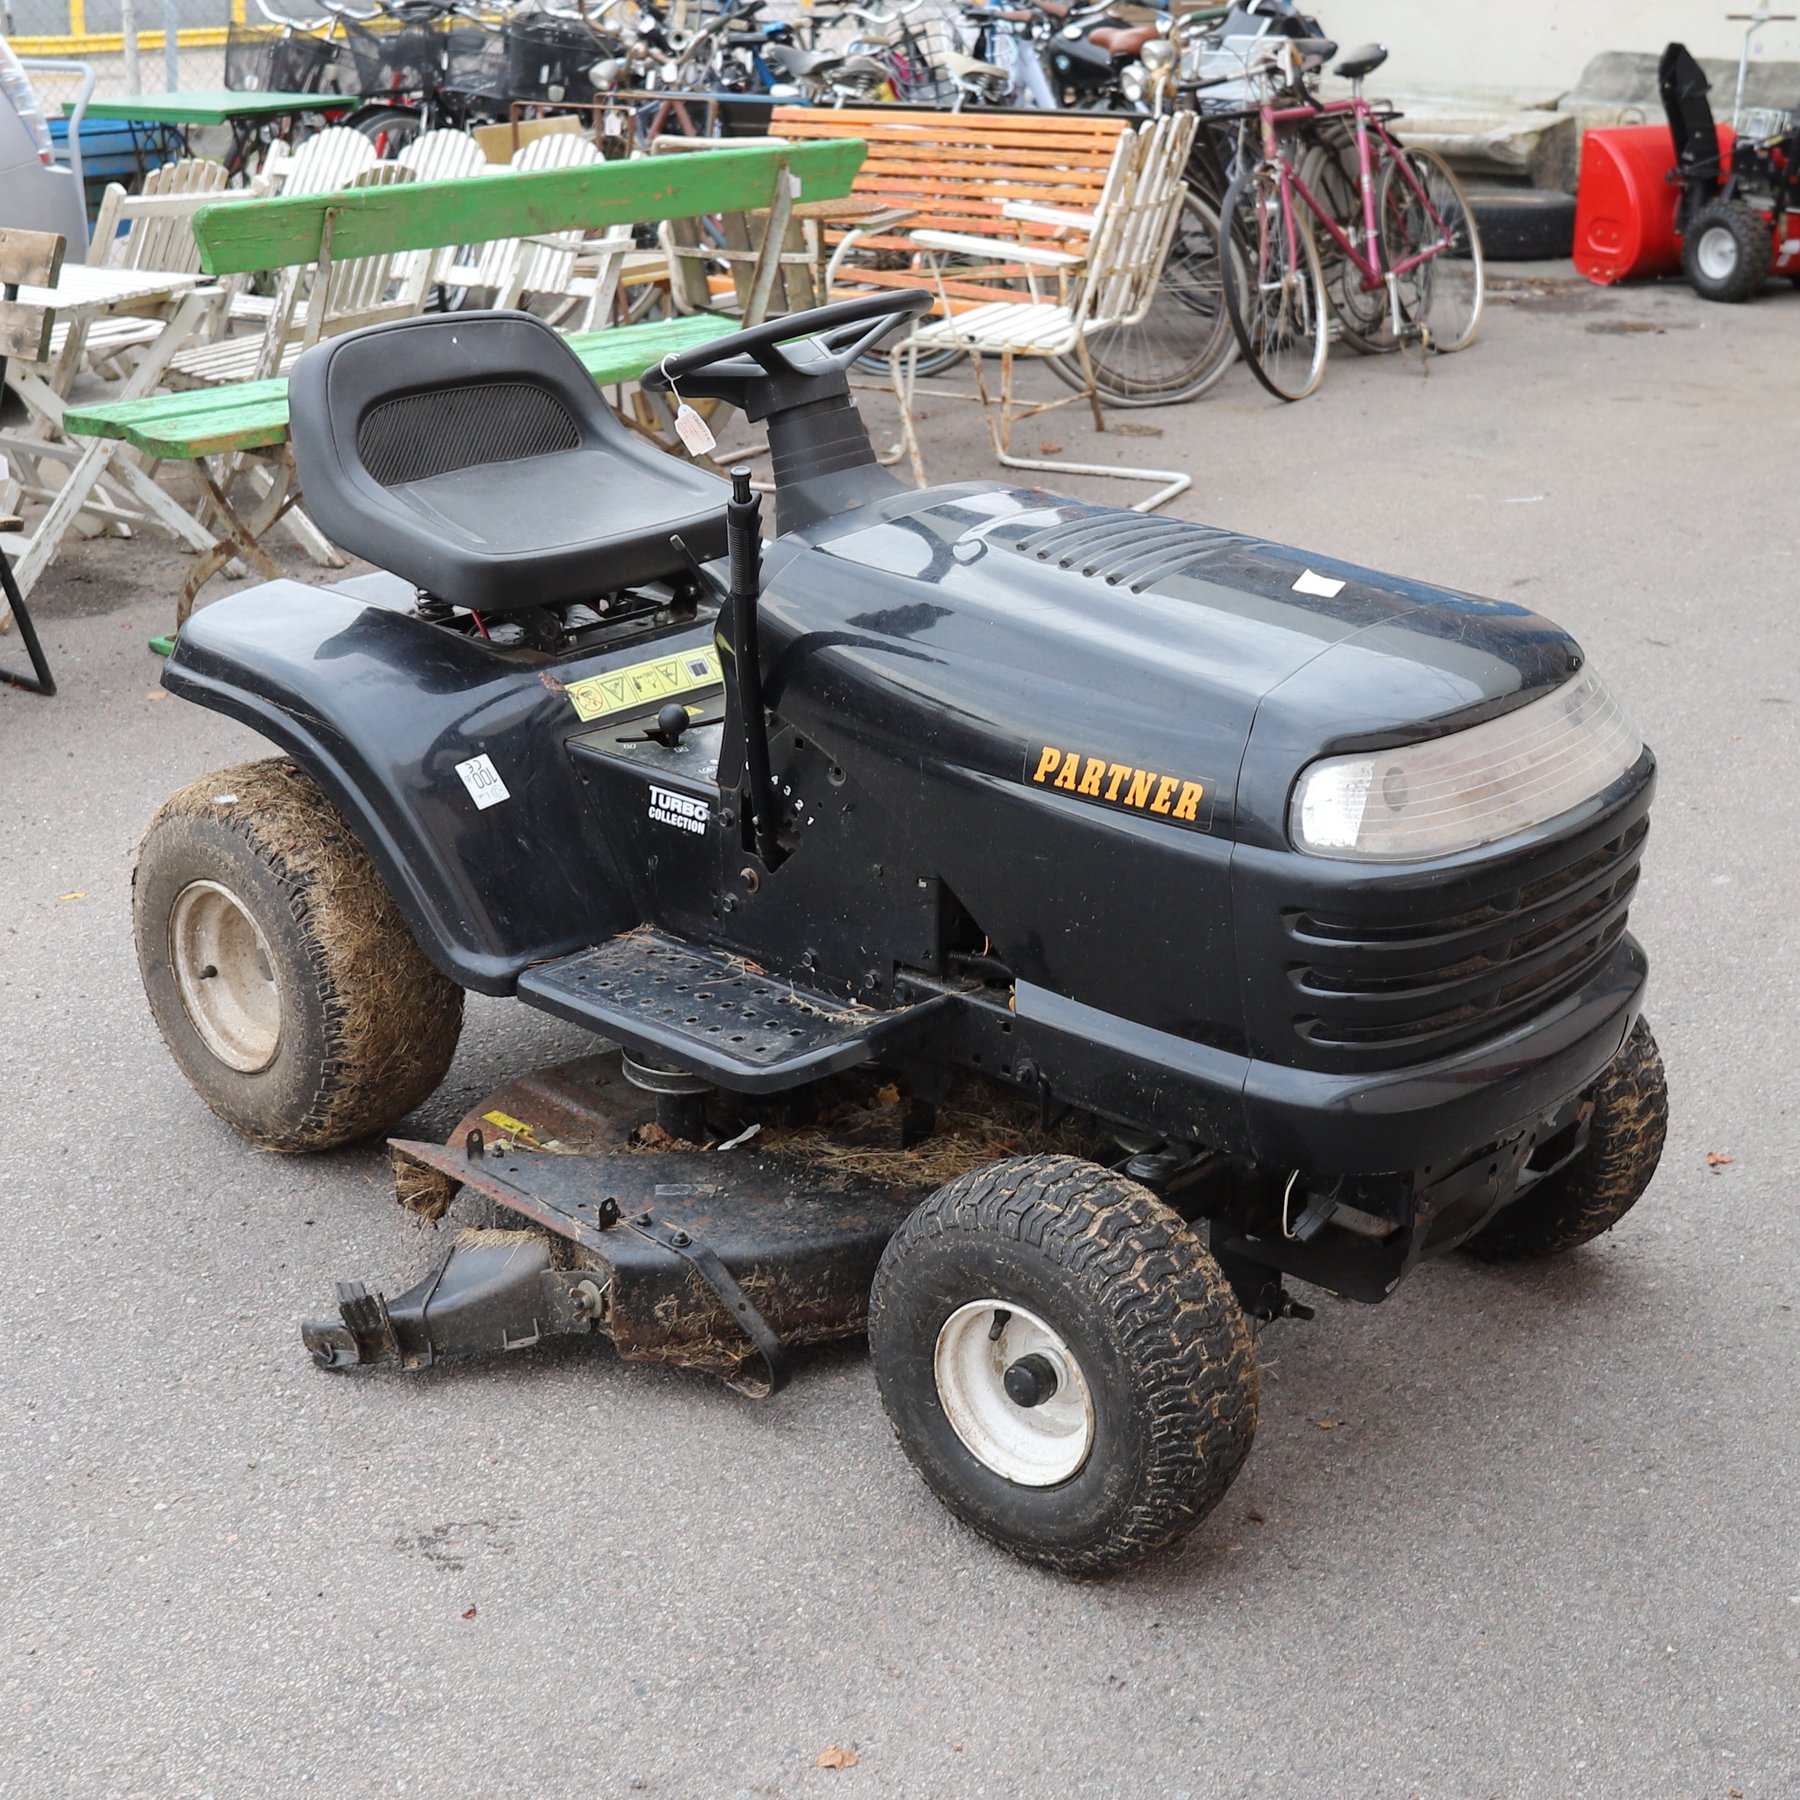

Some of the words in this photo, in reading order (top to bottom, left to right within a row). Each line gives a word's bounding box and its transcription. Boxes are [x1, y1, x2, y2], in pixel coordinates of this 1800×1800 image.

[472, 767, 498, 789] 100
[1033, 746, 1204, 821] PARTNER
[649, 785, 710, 821] TURBO
[783, 785, 792, 796] 3
[794, 799, 804, 811] 2
[648, 806, 706, 835] COLLECTION
